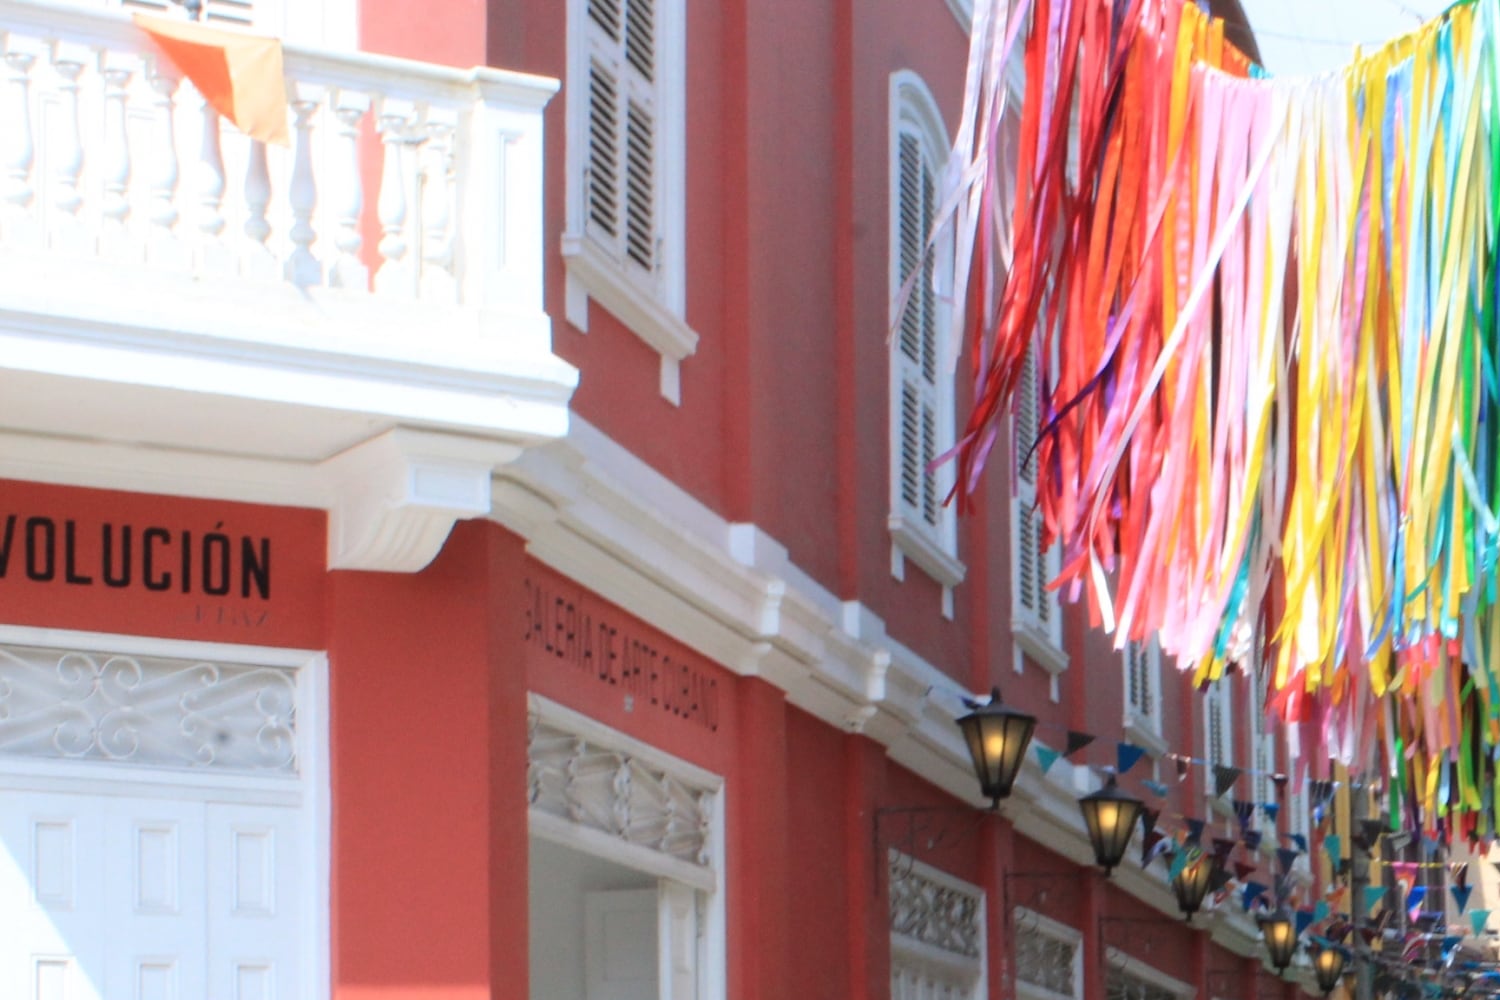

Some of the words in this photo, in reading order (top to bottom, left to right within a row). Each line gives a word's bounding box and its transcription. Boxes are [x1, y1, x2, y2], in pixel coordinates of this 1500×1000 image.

[599, 621, 617, 686] DE
[620, 635, 659, 707] ARTE
[661, 653, 721, 734] CUBANO
